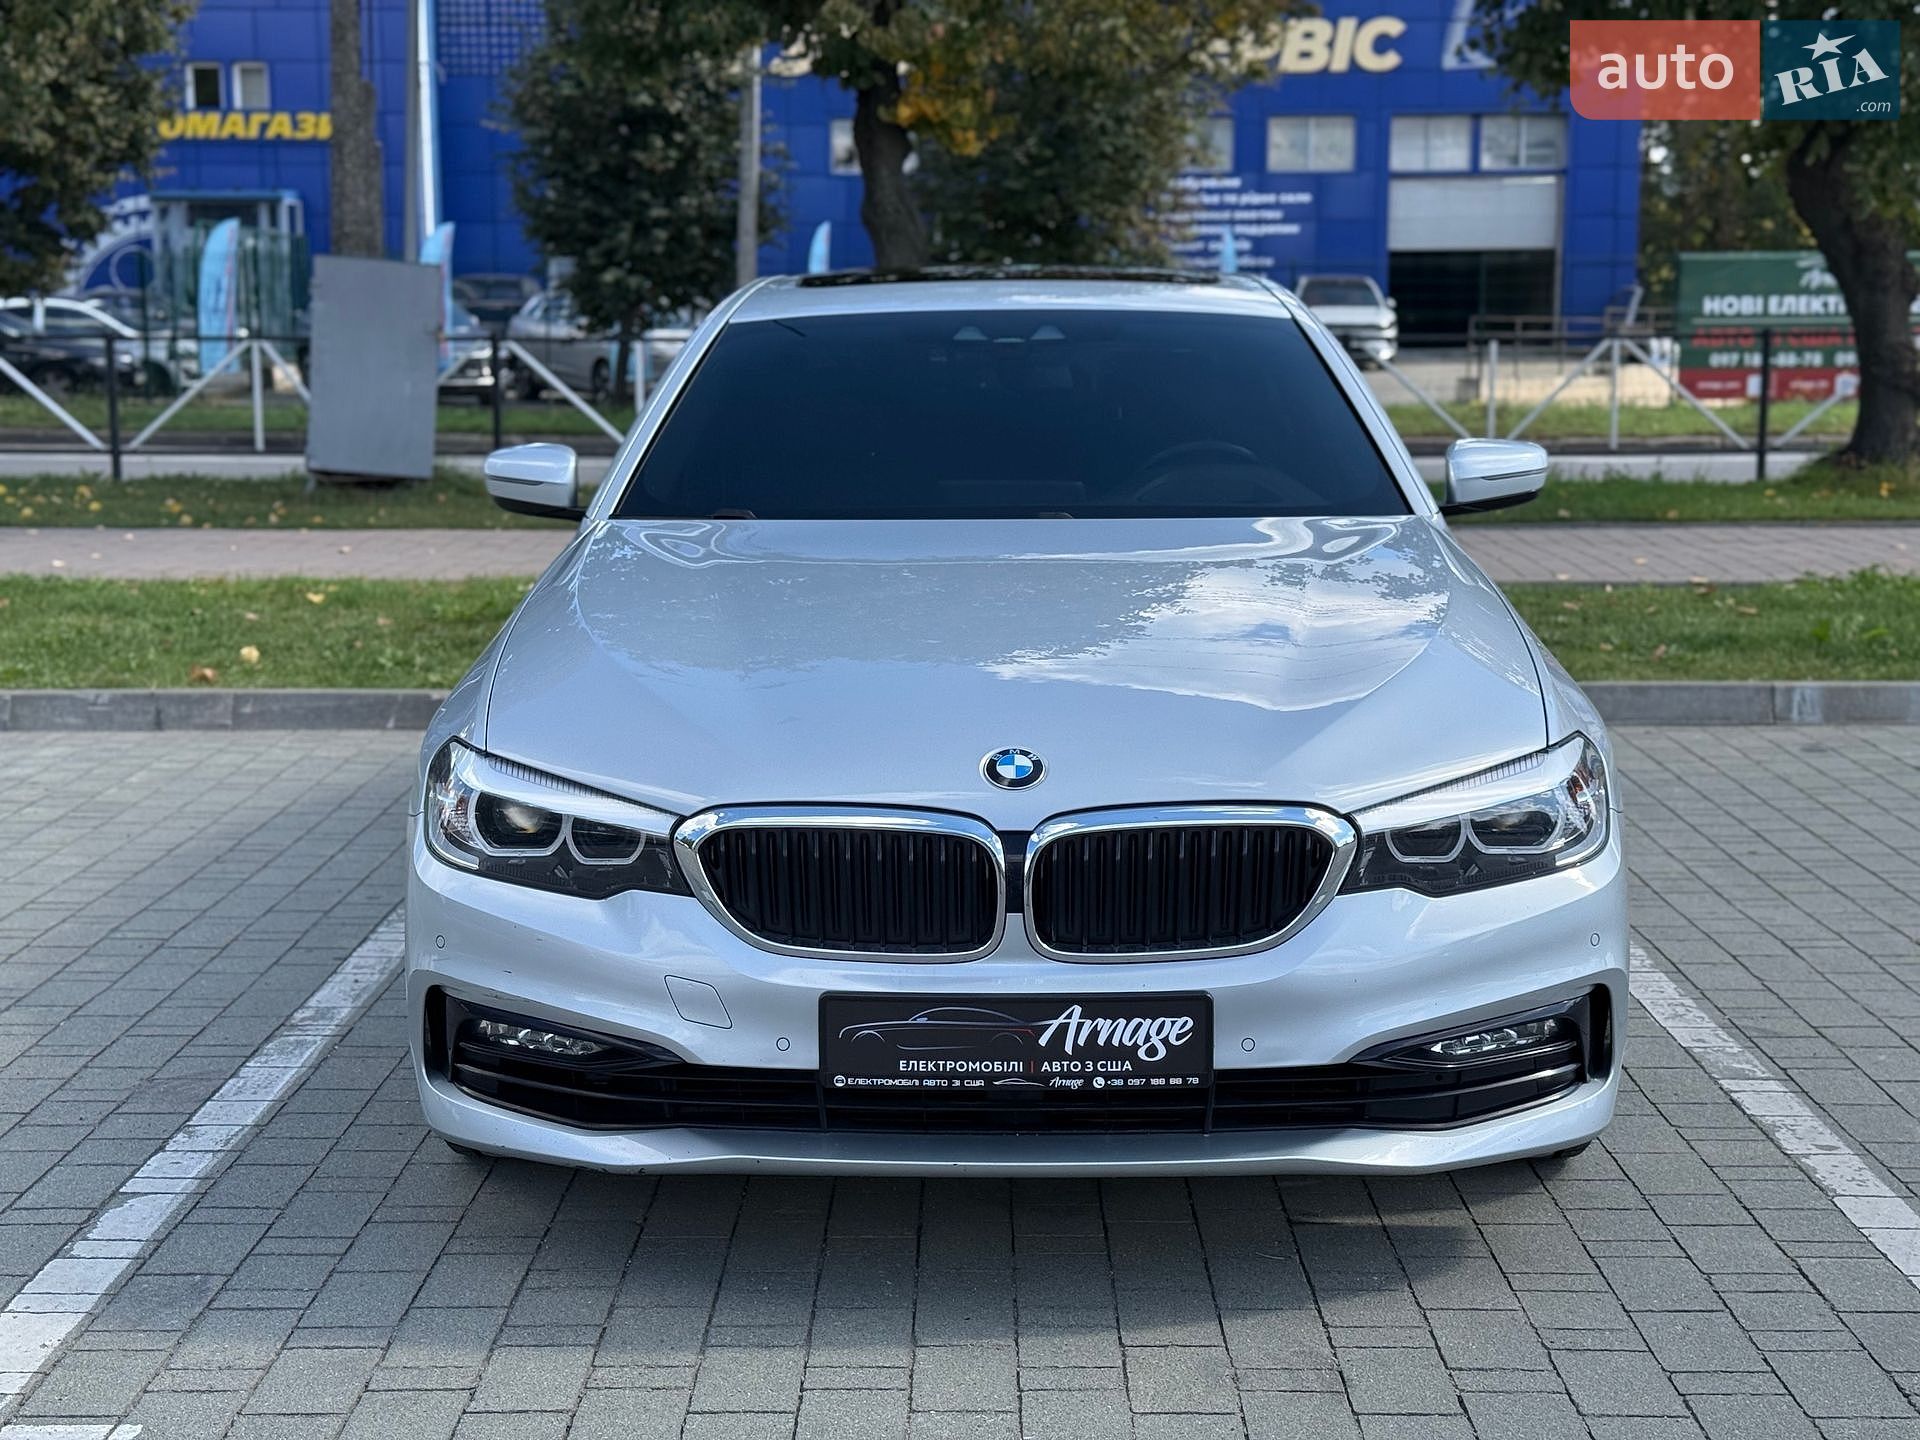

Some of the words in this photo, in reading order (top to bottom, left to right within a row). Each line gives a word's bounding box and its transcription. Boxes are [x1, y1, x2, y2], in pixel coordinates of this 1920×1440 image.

[1702, 294, 1764, 316] НОВІ
[991, 749, 1040, 761] BMW
[1037, 1004, 1195, 1062] Arnage
[899, 1059, 1024, 1073] ЕЛЕКТРОМОБІЛІ
[1040, 1060, 1082, 1073] АВТО
[1096, 1060, 1133, 1072] США
[847, 1077, 920, 1087] ЕЛЕКТРОМОБІЛІ
[922, 1078, 949, 1087] АВТО
[963, 1078, 985, 1087] США
[1049, 1076, 1085, 1090] Arnage
[1106, 1079, 1124, 1087] +38
[1127, 1078, 1147, 1086] 097
[1186, 1077, 1200, 1085] 78
